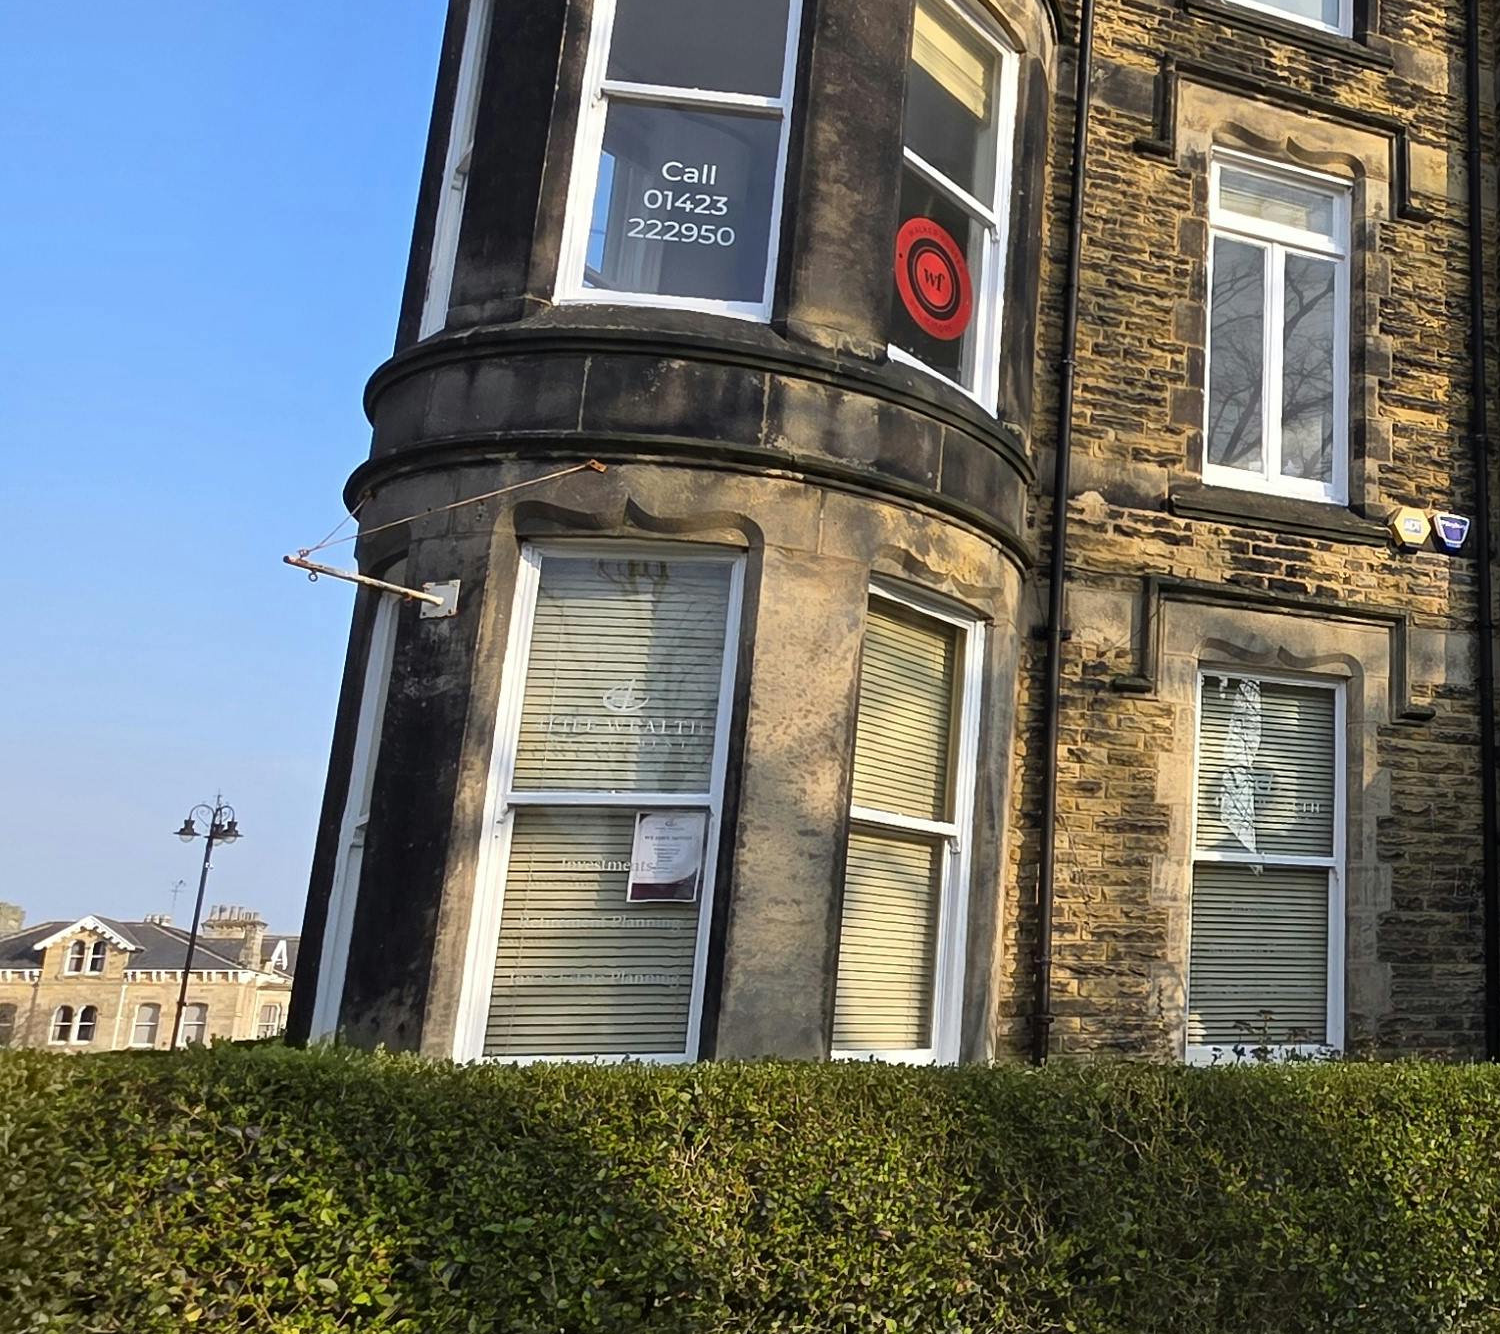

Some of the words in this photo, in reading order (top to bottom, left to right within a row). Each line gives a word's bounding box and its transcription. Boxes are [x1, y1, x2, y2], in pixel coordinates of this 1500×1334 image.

[662, 161, 717, 185] Call
[643, 189, 728, 216] 01423
[627, 218, 735, 246] 222950
[560, 857, 655, 872] Investments
[612, 915, 681, 932] Planning
[611, 970, 680, 987] Planning
